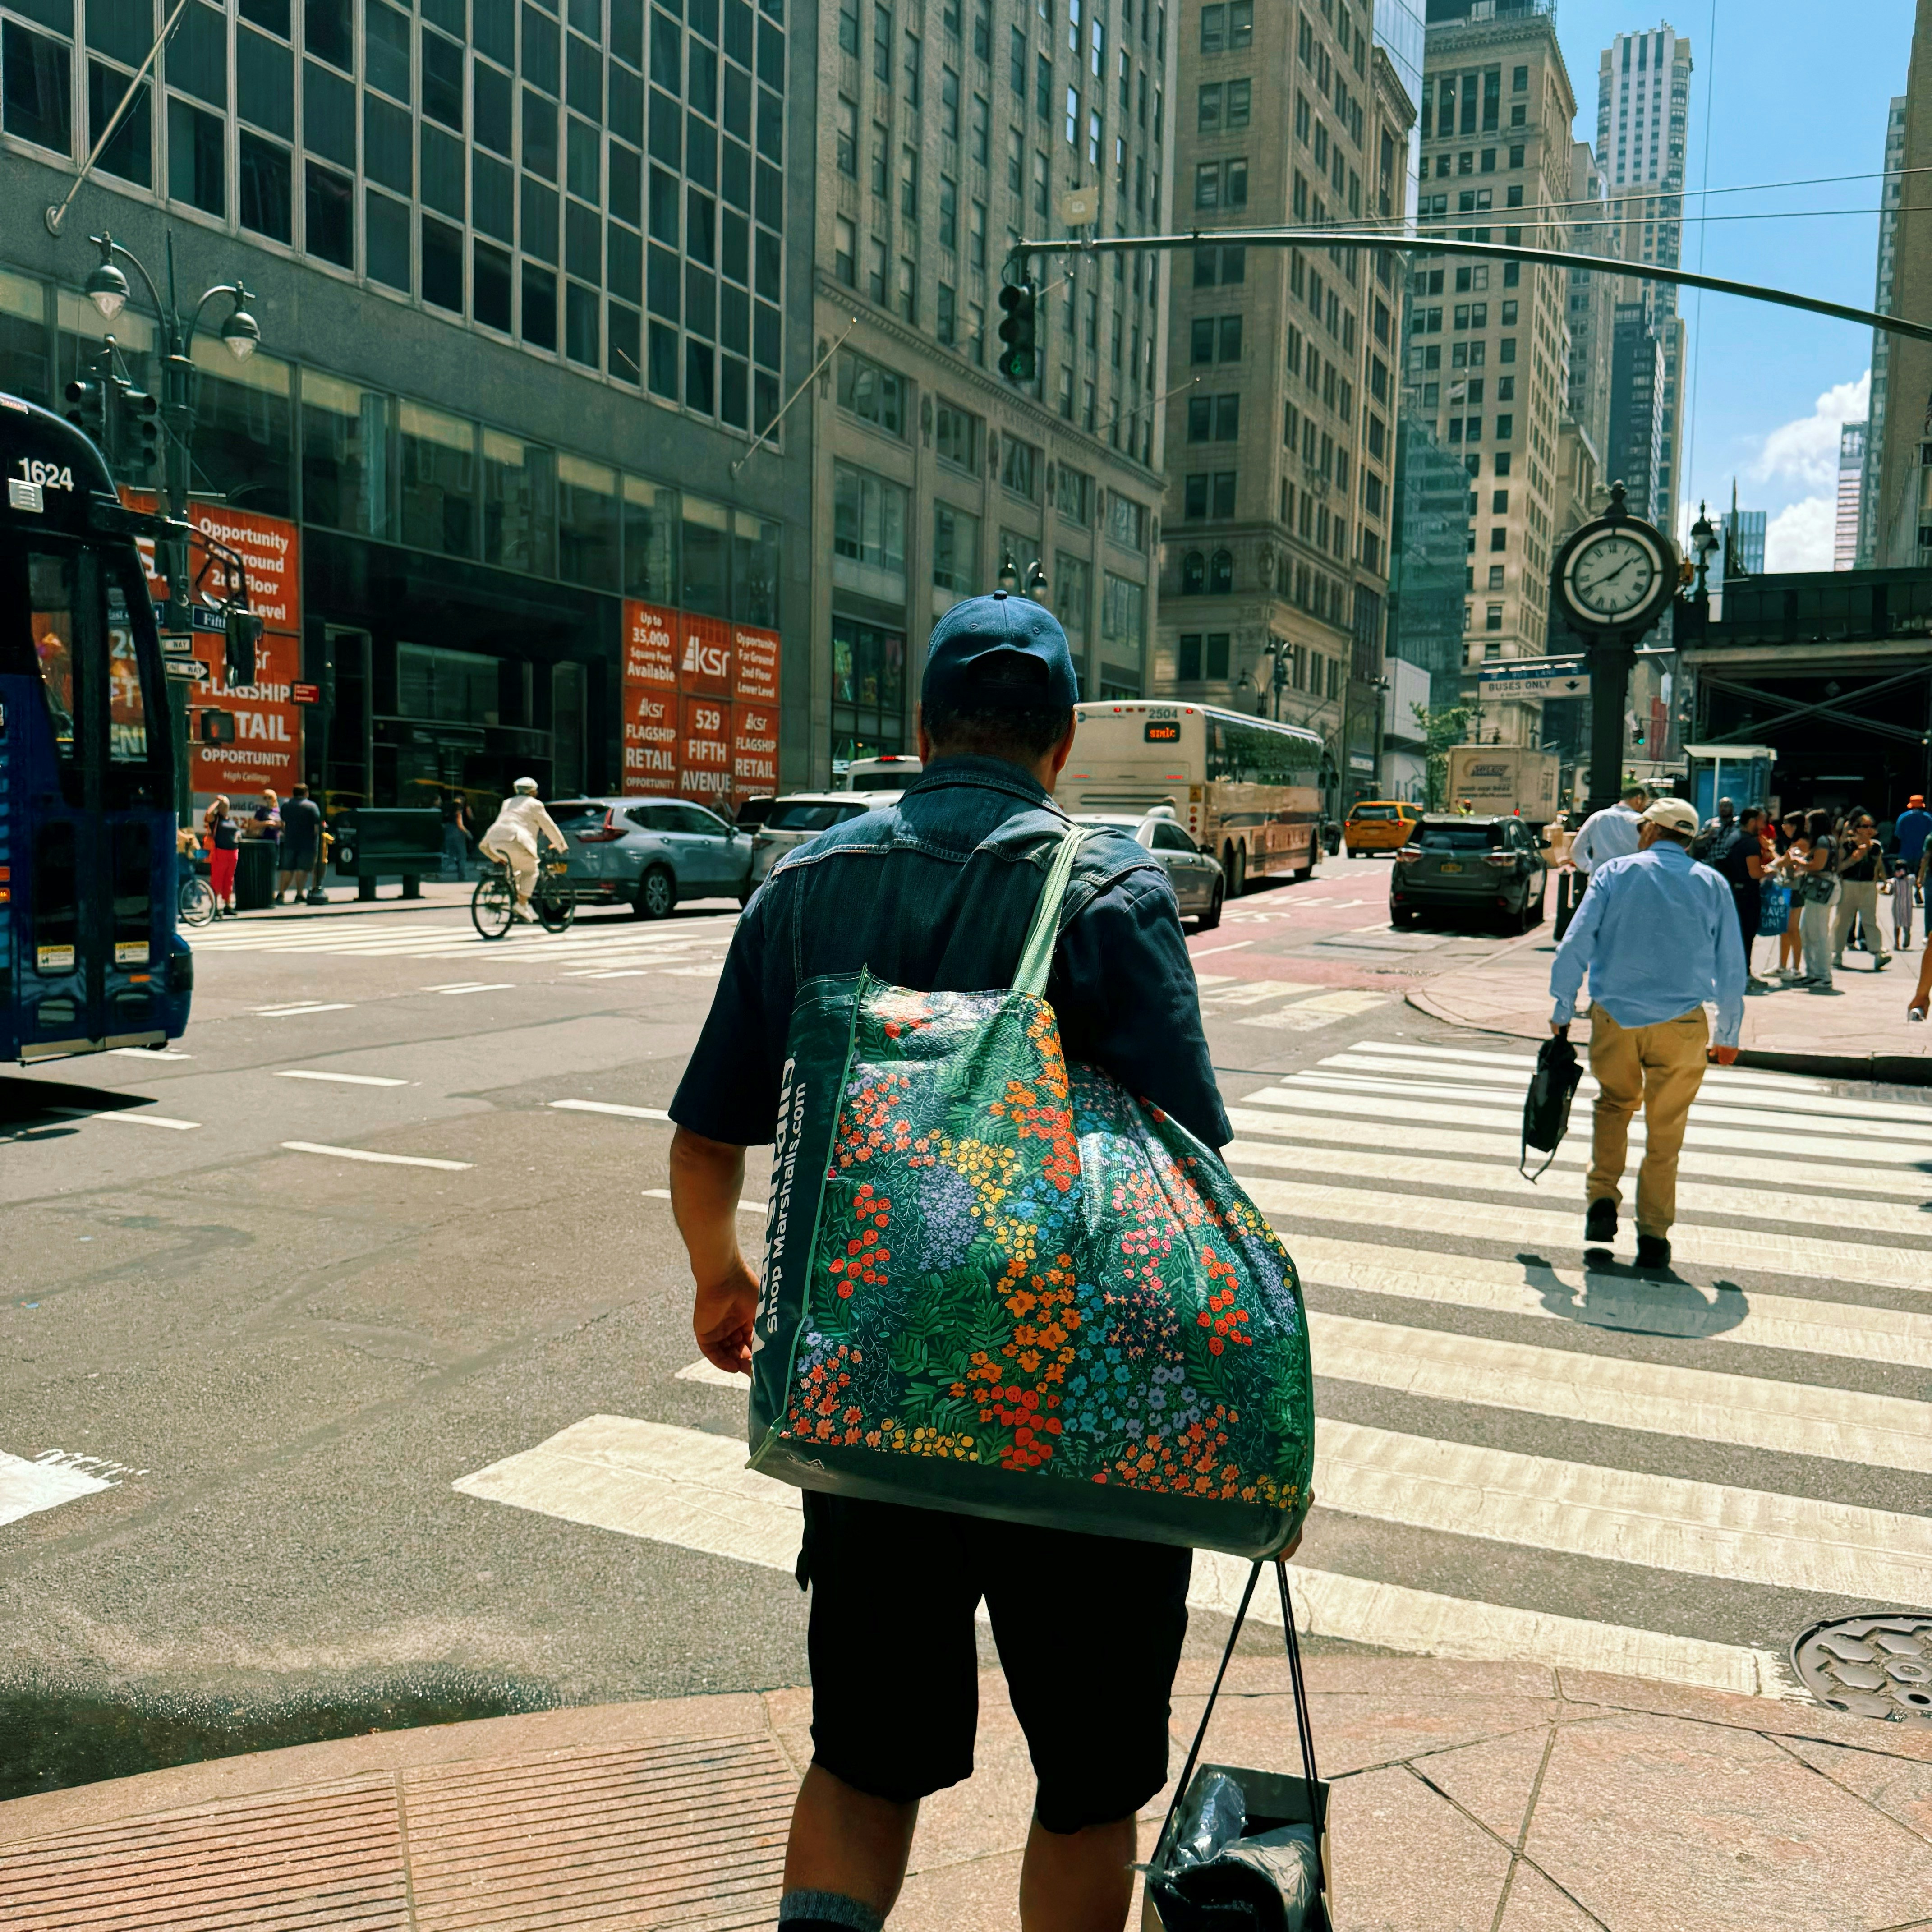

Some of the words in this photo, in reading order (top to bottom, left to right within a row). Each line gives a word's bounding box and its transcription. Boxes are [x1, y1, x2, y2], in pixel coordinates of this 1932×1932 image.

[18, 457, 74, 492] 1624
[200, 517, 289, 554] Opportunity
[249, 599, 286, 621] Level
[640, 612, 652, 627] Up
[653, 614, 662, 627] to
[633, 627, 670, 648] 35,000
[736, 632, 777, 653] Opportunity
[630, 647, 655, 662] Square
[657, 651, 672, 664] Feet
[739, 649, 750, 661] For
[750, 651, 775, 667] Ground
[188, 665, 202, 675] WAY
[627, 661, 675, 682] Available
[742, 666, 754, 678] 2nd
[755, 667, 772, 681] Floor
[200, 677, 290, 703] FLAGSHIP
[737, 681, 757, 695] Lower
[757, 685, 775, 698] Level
[1489, 681, 1521, 692] BUSES
[1526, 680, 1551, 690] ONLY
[695, 708, 721, 731] 529
[1149, 708, 1178, 719] 2504
[235, 710, 291, 742] TAIL
[626, 723, 676, 743] FLAGSHIP
[688, 739, 727, 763] FIFTH
[736, 737, 777, 753] FLAGSHIP
[201, 747, 290, 767] OPPORTUNITY
[626, 747, 676, 772] RETAIL
[735, 758, 775, 779] RETAIL
[626, 777, 676, 789] OPPORTUNITY
[681, 770, 732, 793] AVENUE
[736, 784, 775, 796] OPPORTUNITY
[772, 1082, 806, 1259] Marshalls.com
[767, 1265, 783, 1334] Shop
